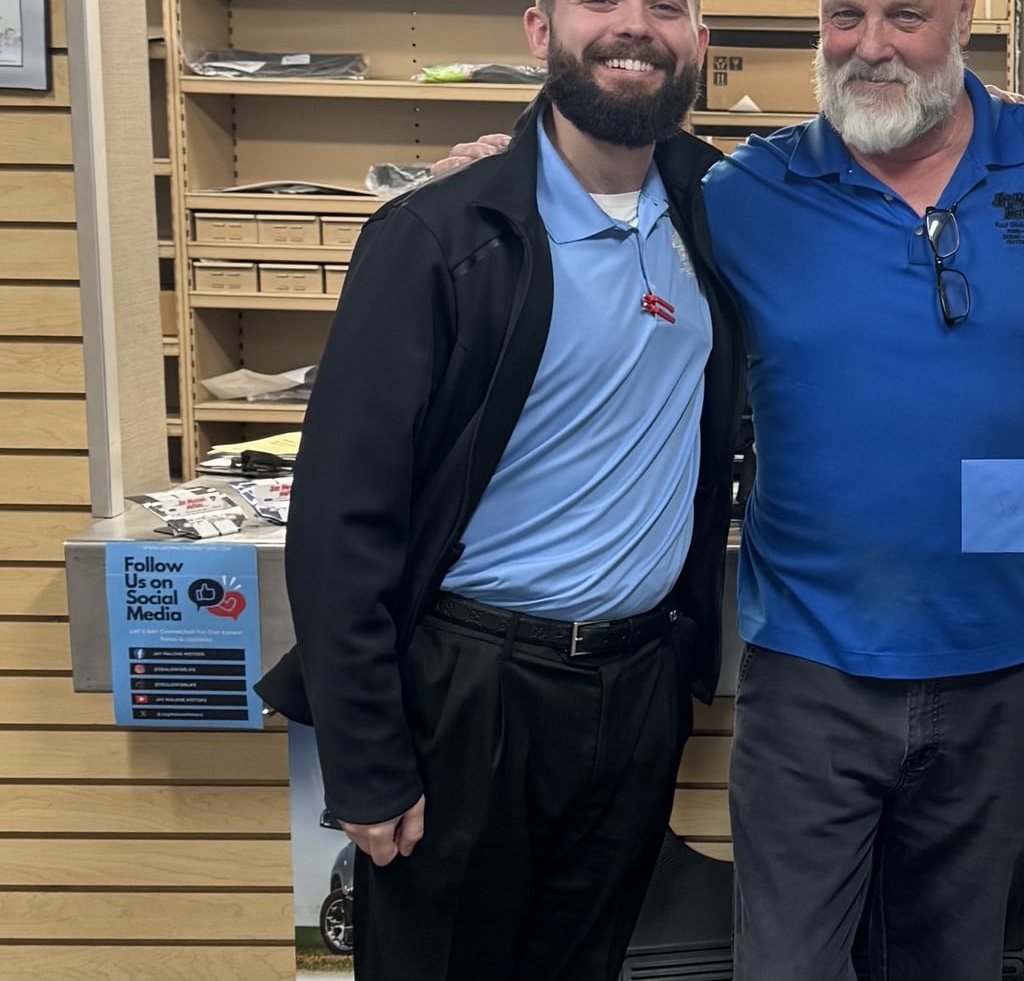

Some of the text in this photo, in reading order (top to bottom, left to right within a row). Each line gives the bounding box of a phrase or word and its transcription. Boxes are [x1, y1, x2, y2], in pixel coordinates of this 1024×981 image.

[124, 556, 184, 573] Follow
[125, 573, 173, 589] Us on
[126, 590, 178, 605] Social
[126, 606, 182, 621] Media
